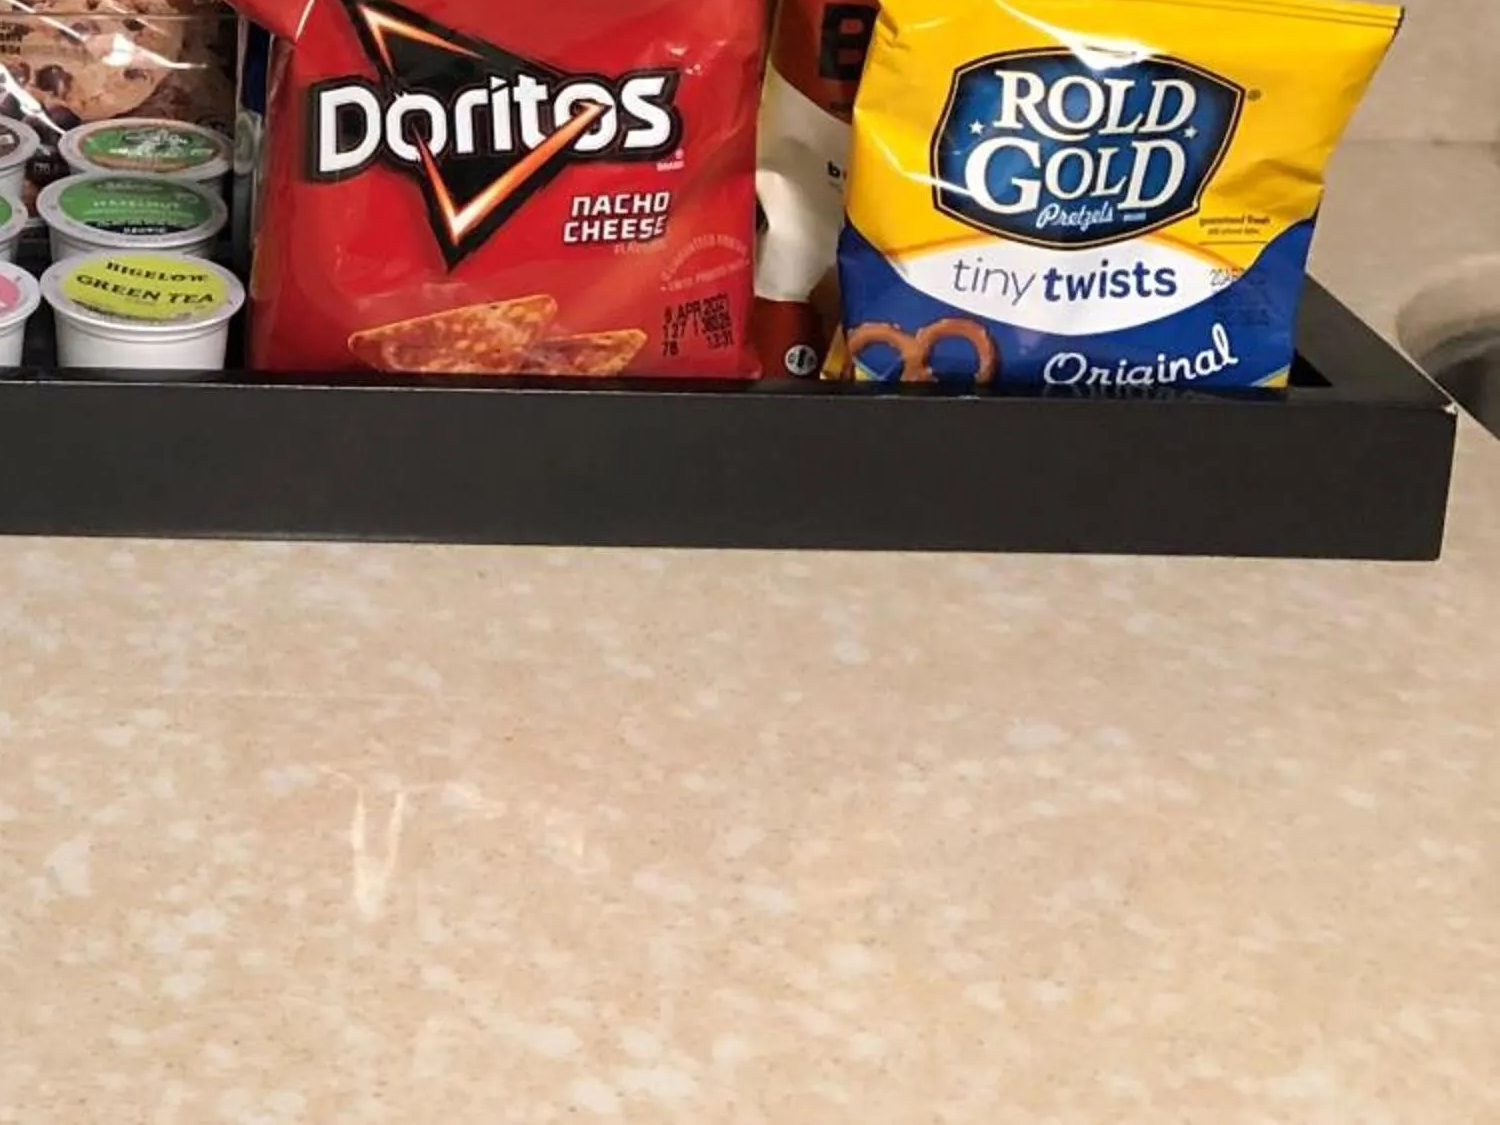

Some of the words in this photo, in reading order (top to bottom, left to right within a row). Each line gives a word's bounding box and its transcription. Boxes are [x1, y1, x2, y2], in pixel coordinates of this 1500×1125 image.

[319, 74, 672, 172] Doritos
[992, 70, 1197, 141] ROLD
[964, 136, 1187, 214] GOLD
[572, 191, 670, 217] NACHO
[1036, 201, 1114, 231] Pretzels
[563, 215, 668, 243] CHEESE
[76, 274, 161, 301] GREEN
[167, 291, 214, 304] TEA
[105, 261, 209, 283] BIGELOW
[953, 257, 1037, 306] tiny
[1043, 261, 1177, 301] twists
[1043, 322, 1239, 386] Original
